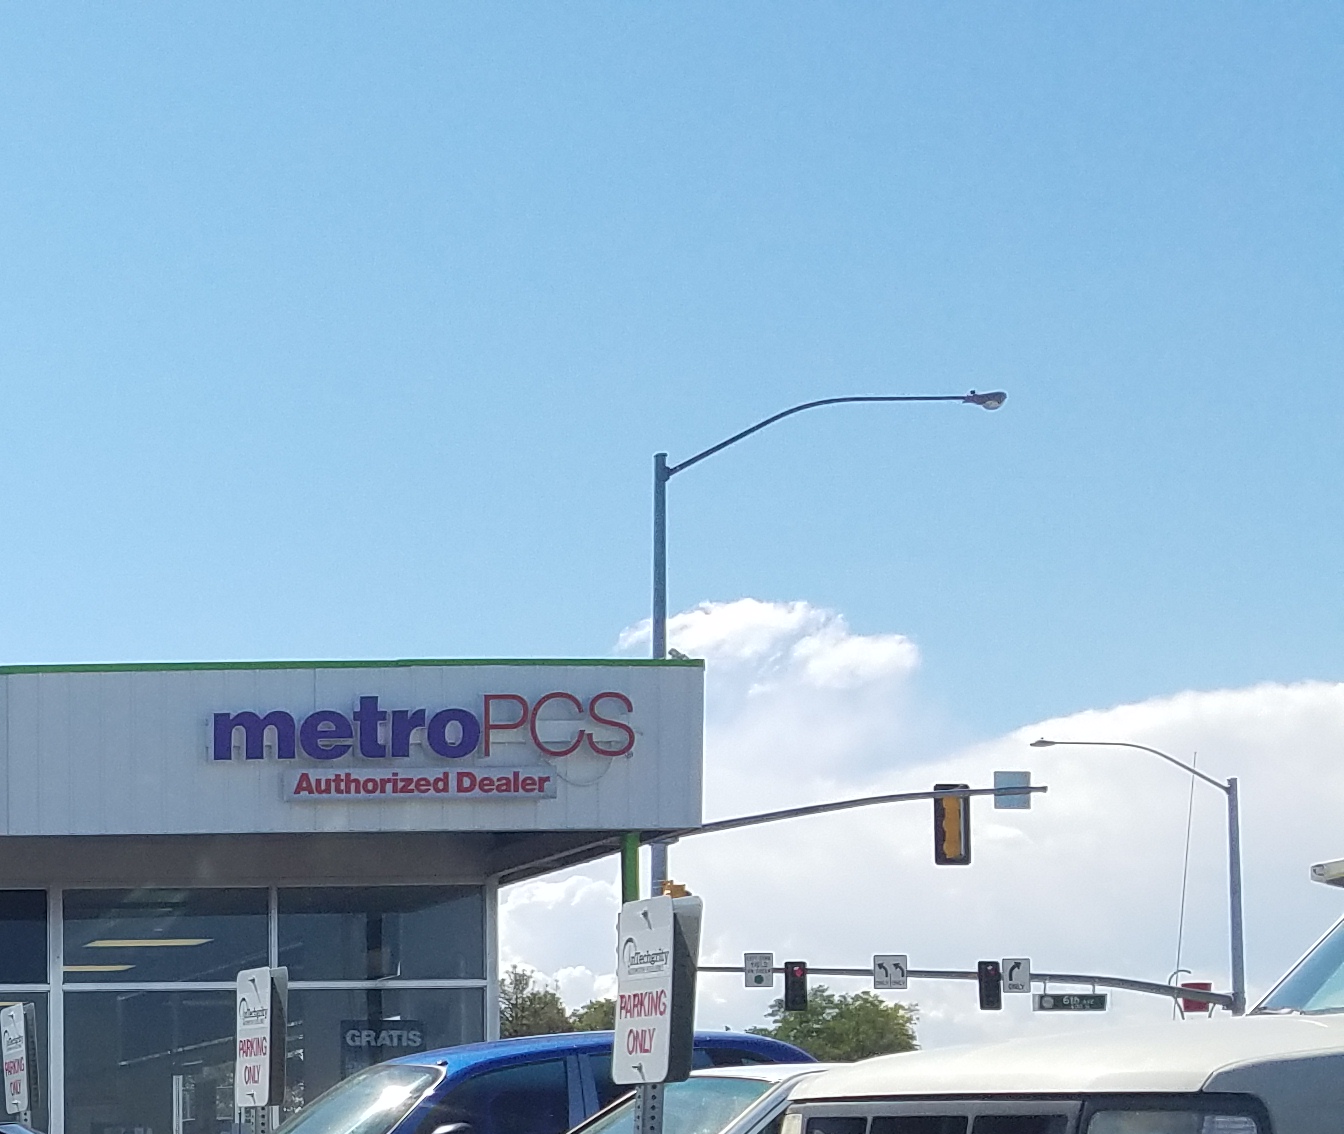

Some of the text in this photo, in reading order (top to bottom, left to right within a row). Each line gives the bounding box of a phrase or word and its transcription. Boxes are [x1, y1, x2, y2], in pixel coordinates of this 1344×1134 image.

[213, 691, 636, 761] metroPCS
[293, 771, 551, 795] Authorized Dealer
[619, 989, 668, 1019] PARKING
[238, 1036, 268, 1058] PARKING
[345, 1029, 423, 1047] GRATIS
[626, 1027, 656, 1055] ONLY
[4, 1056, 25, 1077] PARKING
[243, 1064, 261, 1085] ONLY
